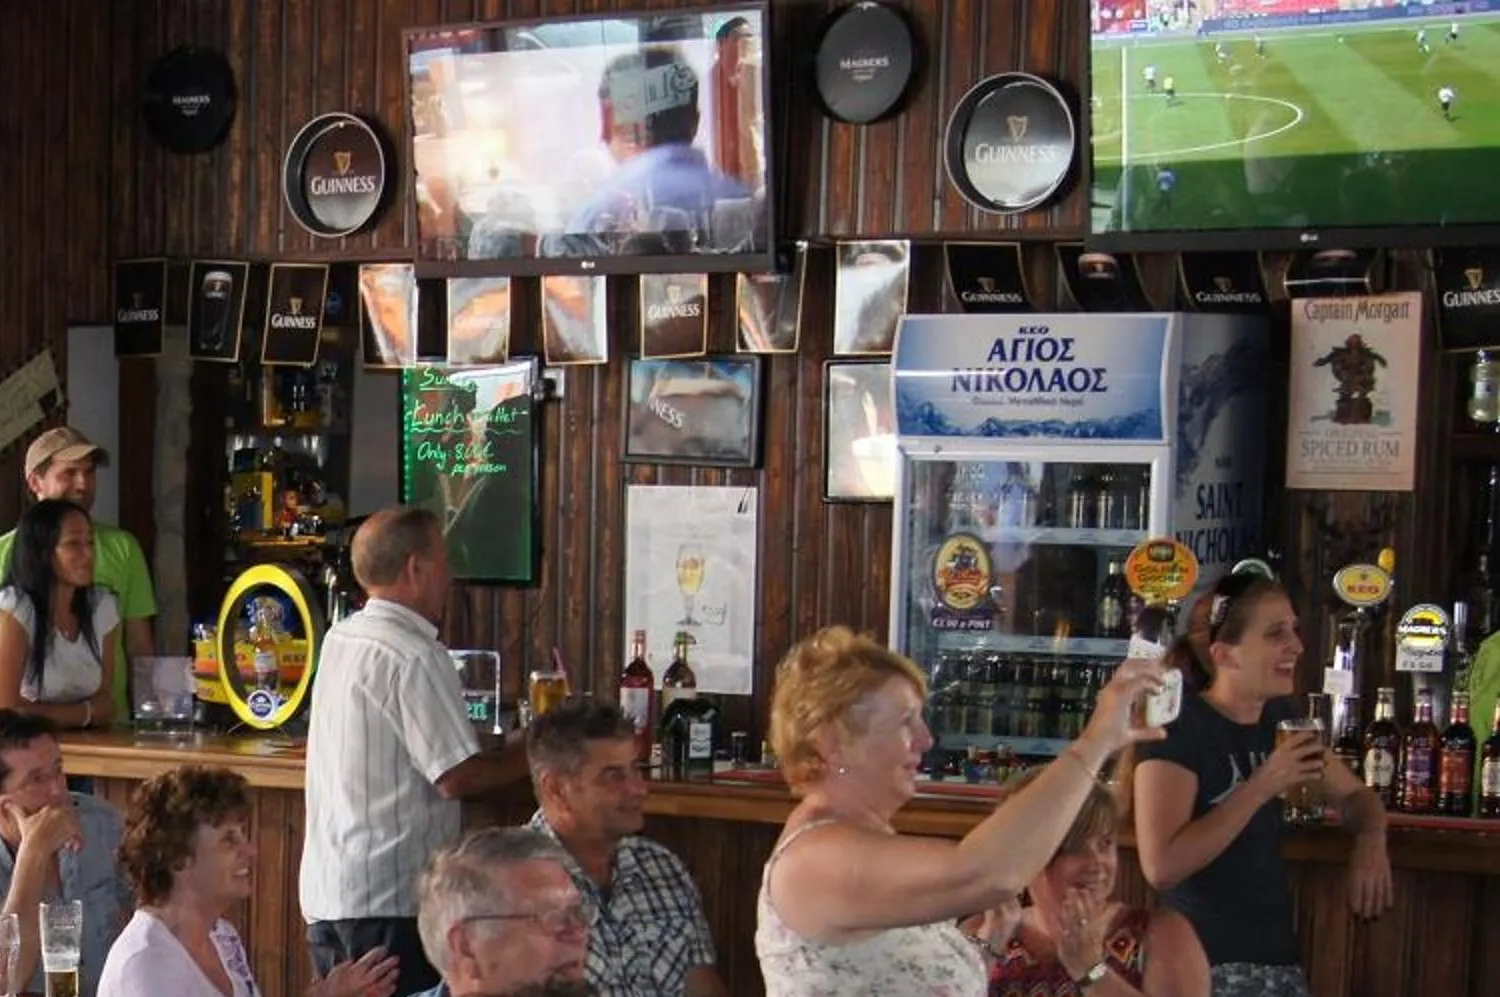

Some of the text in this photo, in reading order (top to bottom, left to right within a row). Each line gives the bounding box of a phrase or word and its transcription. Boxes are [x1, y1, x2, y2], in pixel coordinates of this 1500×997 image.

[975, 143, 1058, 163] GUINNESS
[311, 175, 376, 195] GUINNESS
[961, 291, 1022, 303] GUINNESS
[1195, 291, 1260, 303] GUINNESS
[118, 309, 160, 322] GUINNESS
[271, 313, 317, 329] GUINNESS
[648, 303, 701, 319] GUINNESS
[1304, 299, 1411, 324] Captain Morgan
[987, 337, 1076, 363] ΑΓΙΟΣ
[952, 367, 1109, 393] ΝΙΚΟΛΑΟΣ
[411, 399, 465, 427] Lunch
[417, 441, 447, 470] Only
[1301, 439, 1399, 457] SPICED RUM
[1195, 481, 1244, 519] SAINT
